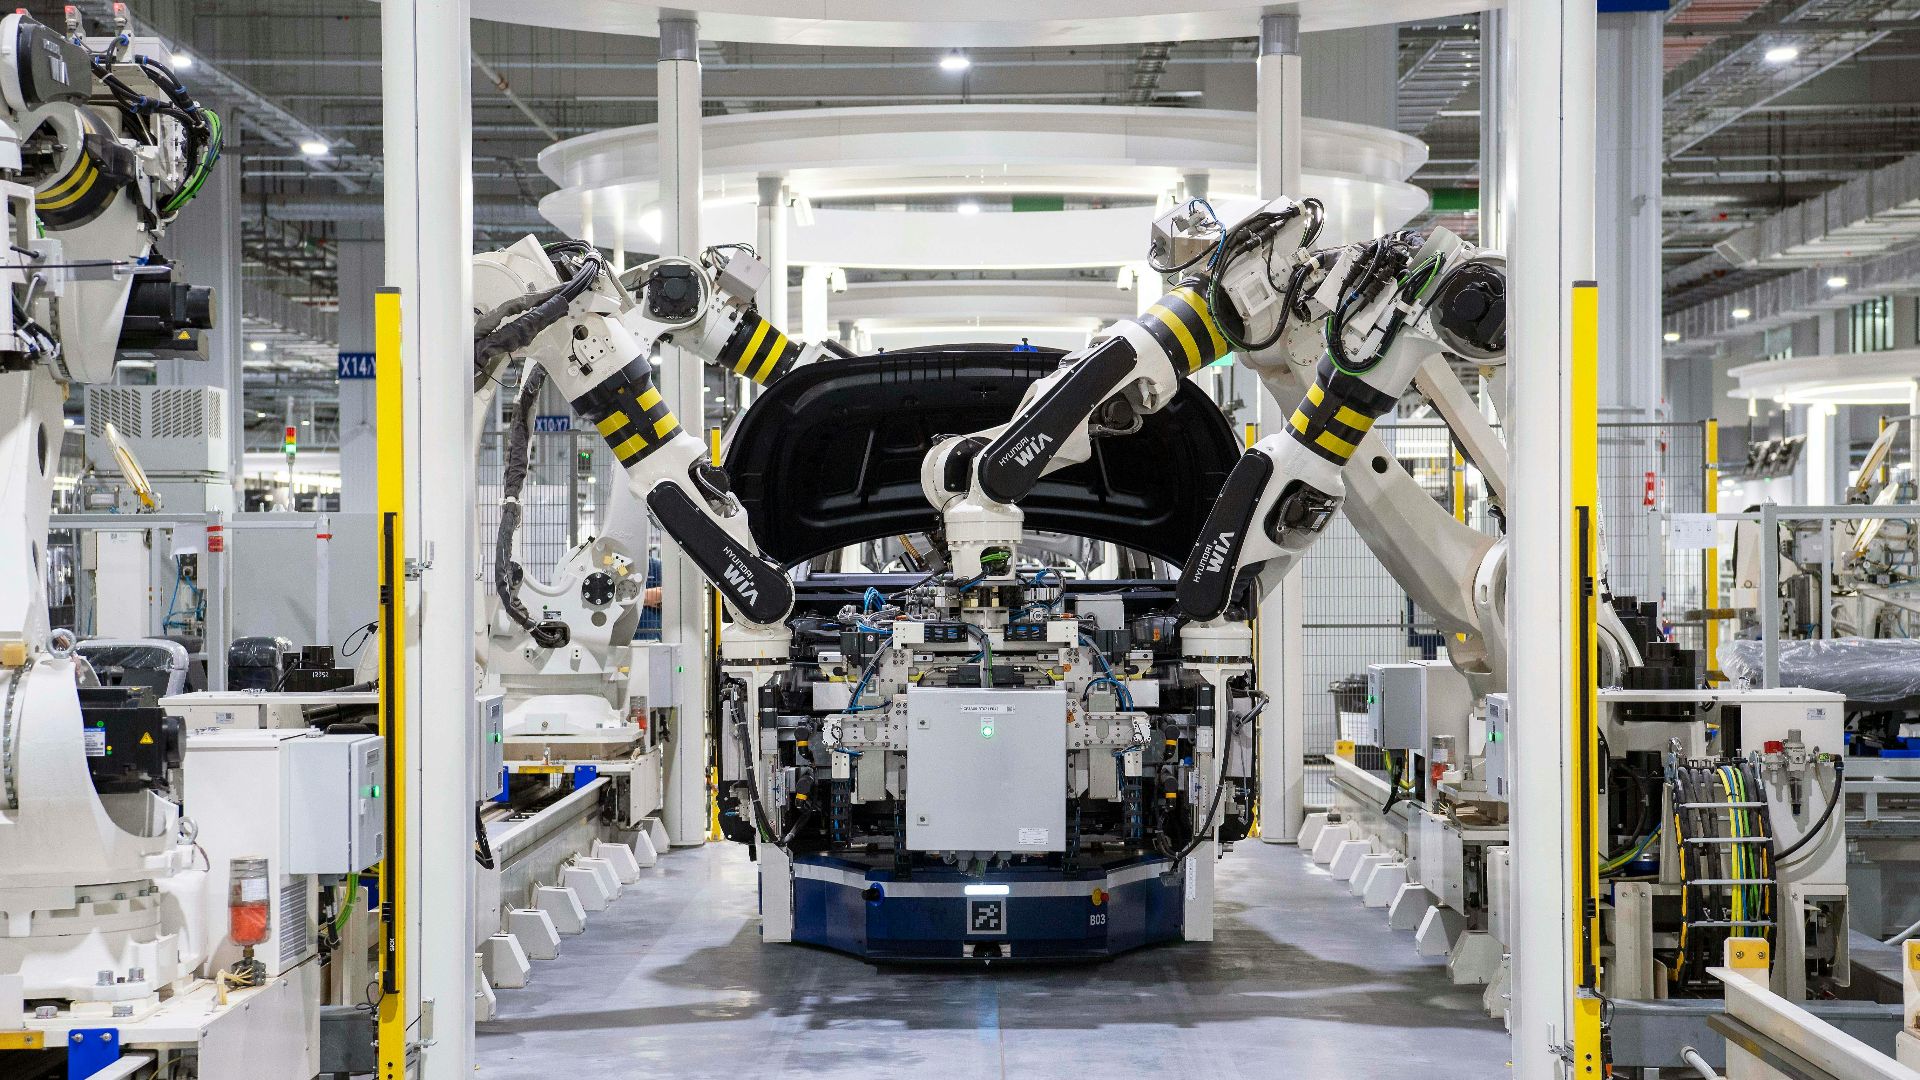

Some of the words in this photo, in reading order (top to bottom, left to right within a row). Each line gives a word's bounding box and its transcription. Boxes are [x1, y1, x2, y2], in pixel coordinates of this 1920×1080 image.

[998, 436, 1030, 467] HYUNDAI
[722, 546, 755, 580] HYUNDAI
[1193, 543, 1213, 583] HYUNDAI
[1090, 913, 1106, 926] B03
